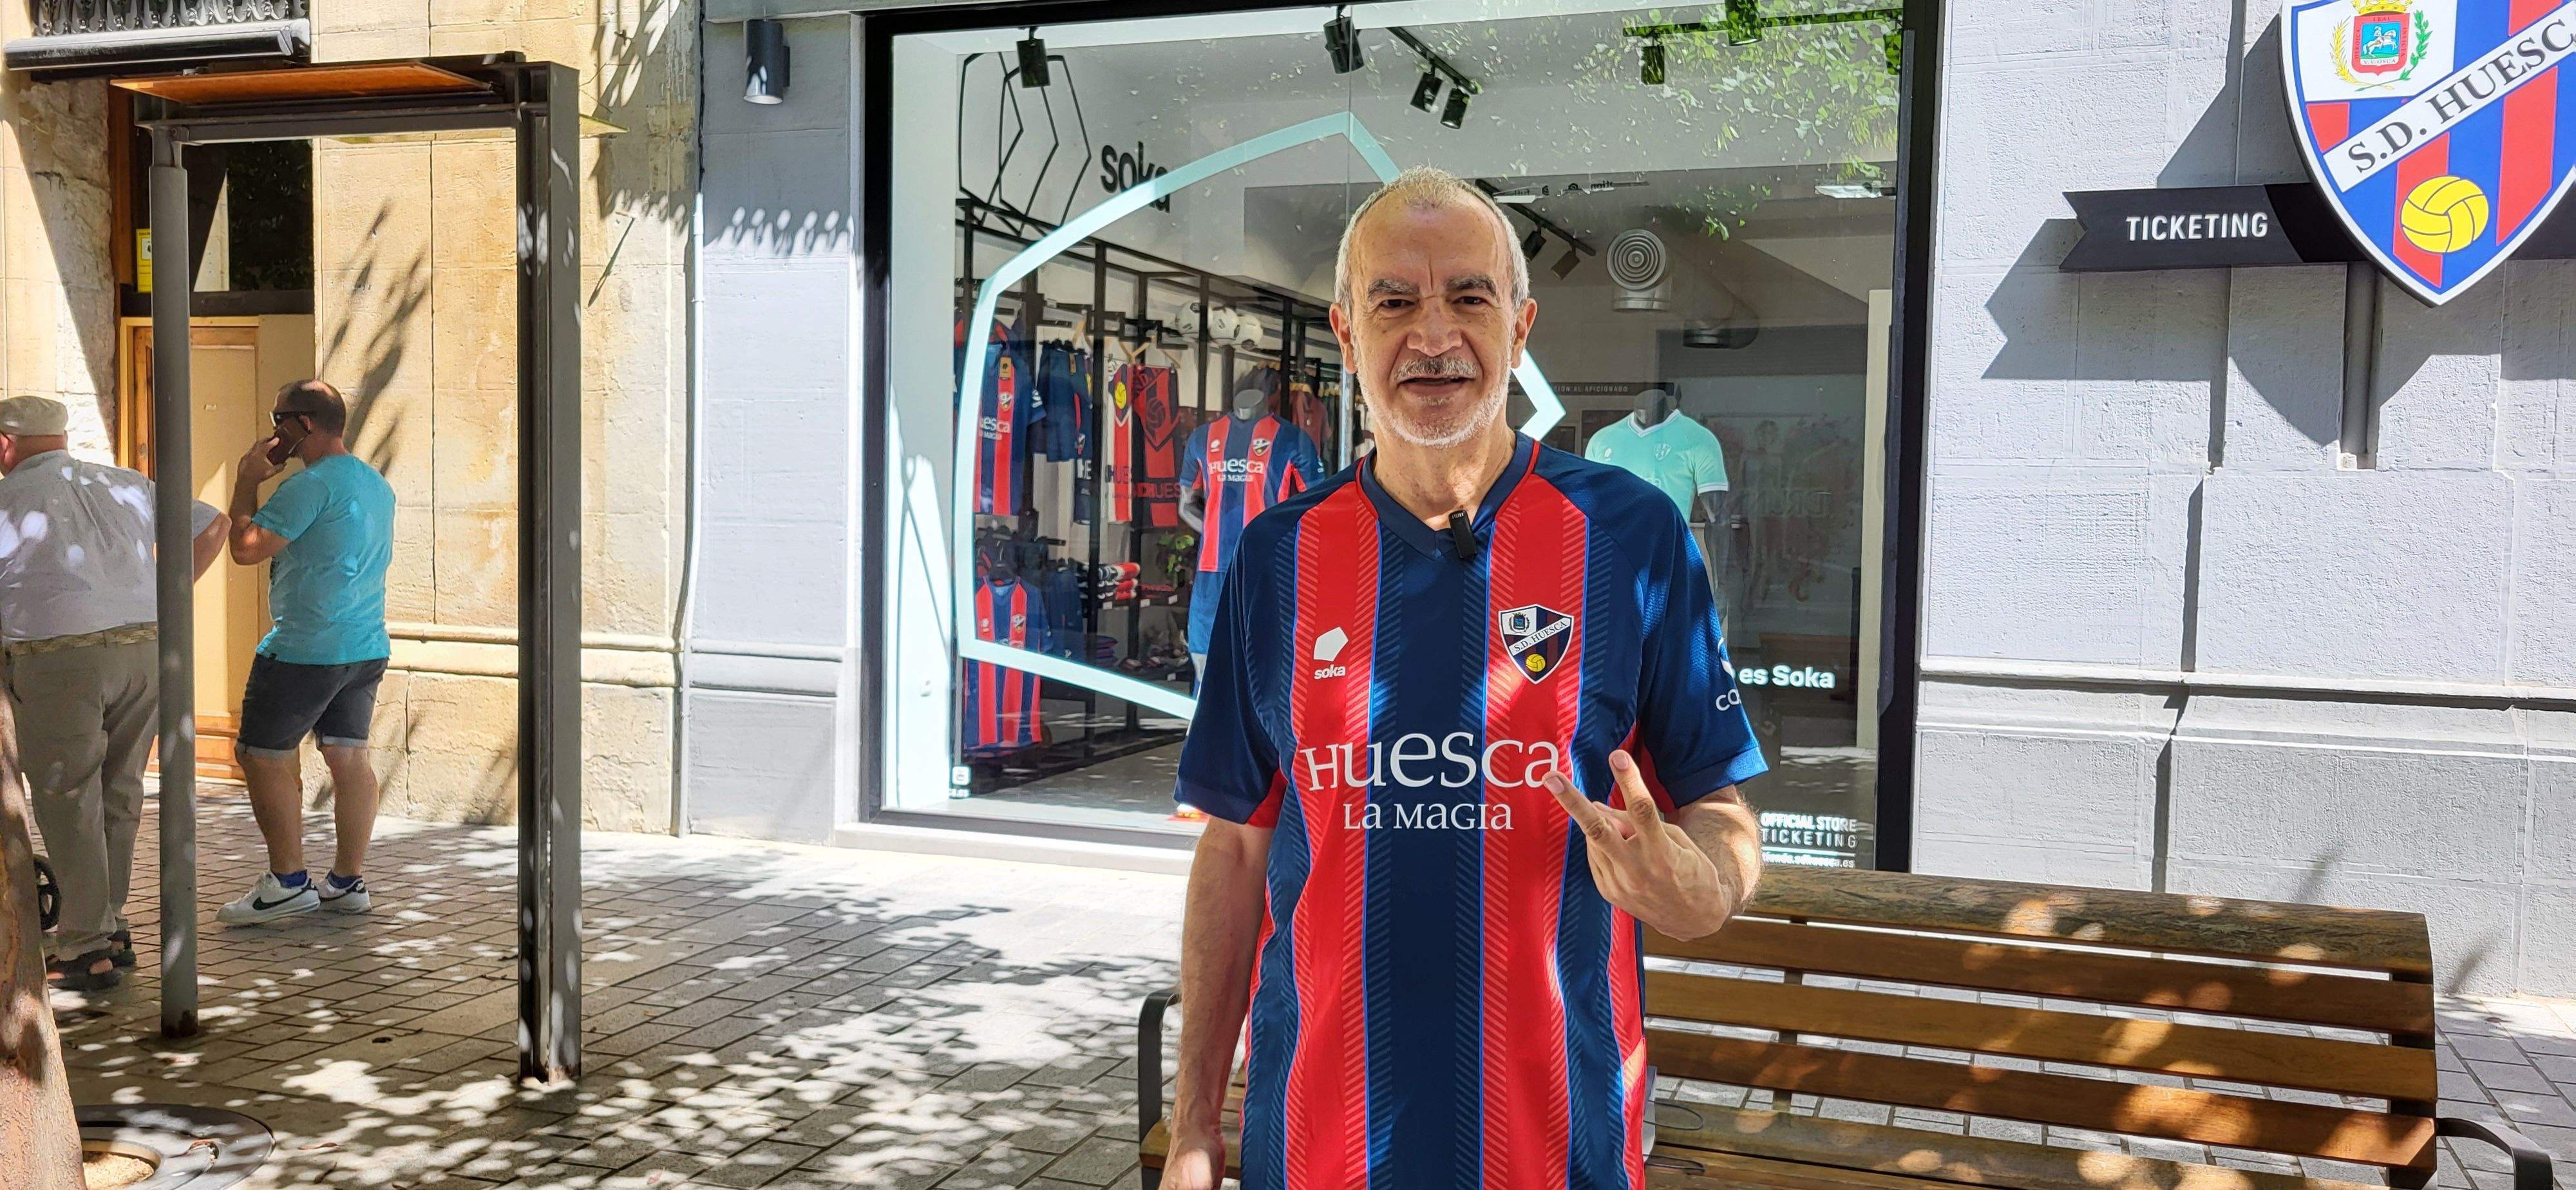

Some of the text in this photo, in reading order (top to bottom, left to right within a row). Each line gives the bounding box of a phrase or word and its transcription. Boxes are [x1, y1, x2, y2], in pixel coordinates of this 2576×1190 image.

[2348, 18, 2576, 173] S.D. HUESC
[2126, 212, 2268, 241] TICKETING
[1514, 621, 1567, 652] S.D. HUESCA
[1314, 664, 1346, 680] soka
[1739, 665, 1835, 688] es Soka
[1300, 732, 1559, 791] Huesca
[1761, 812, 1857, 833] OFFICIAL STORE
[1761, 828, 1857, 848] TICKETING
